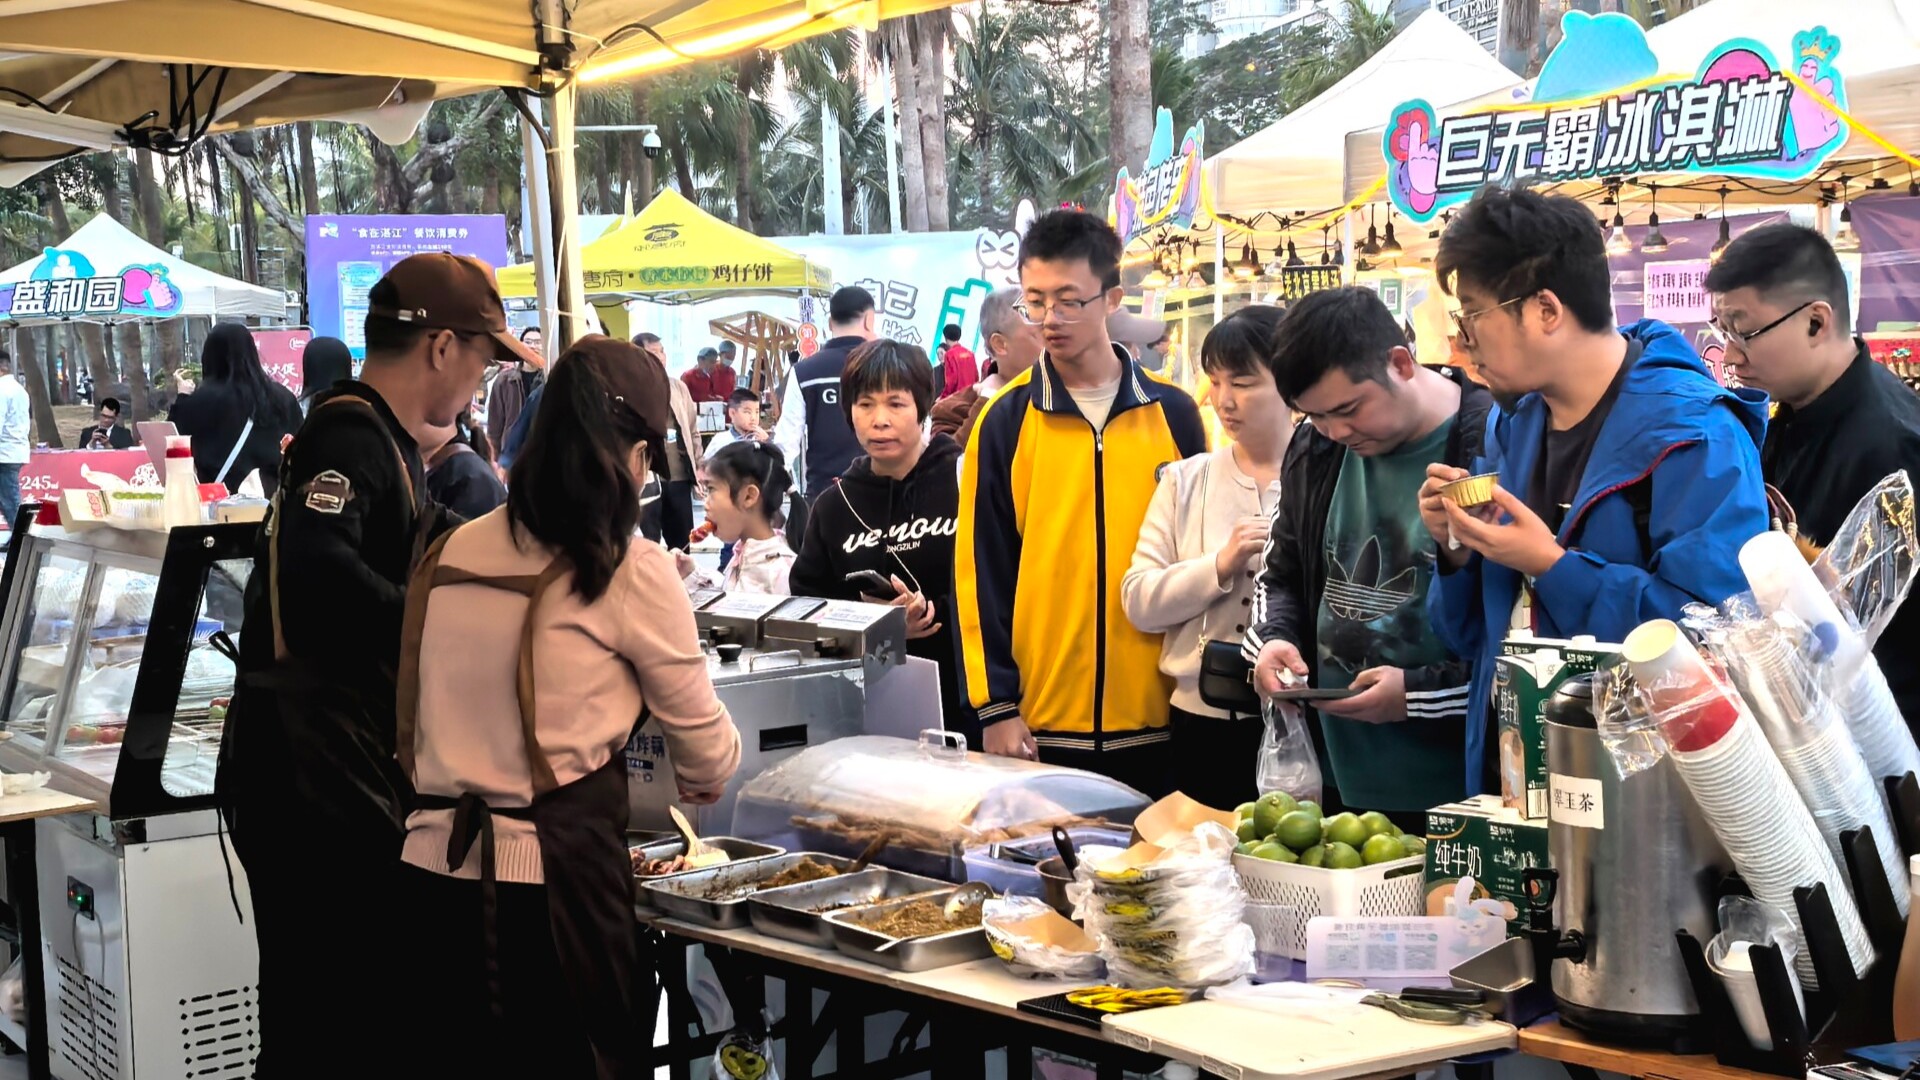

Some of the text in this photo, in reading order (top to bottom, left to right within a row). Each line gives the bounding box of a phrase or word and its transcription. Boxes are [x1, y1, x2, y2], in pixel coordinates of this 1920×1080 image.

[1436, 74, 1788, 189] 巨无霸冰淇淋
[414, 227, 469, 239] 餐饮消费券
[713, 263, 774, 283] 鸡仔饼
[10, 276, 124, 317] 盛和园
[1554, 788, 1595, 813] 翠玉茶
[1434, 839, 1482, 878] 纯牛奶
